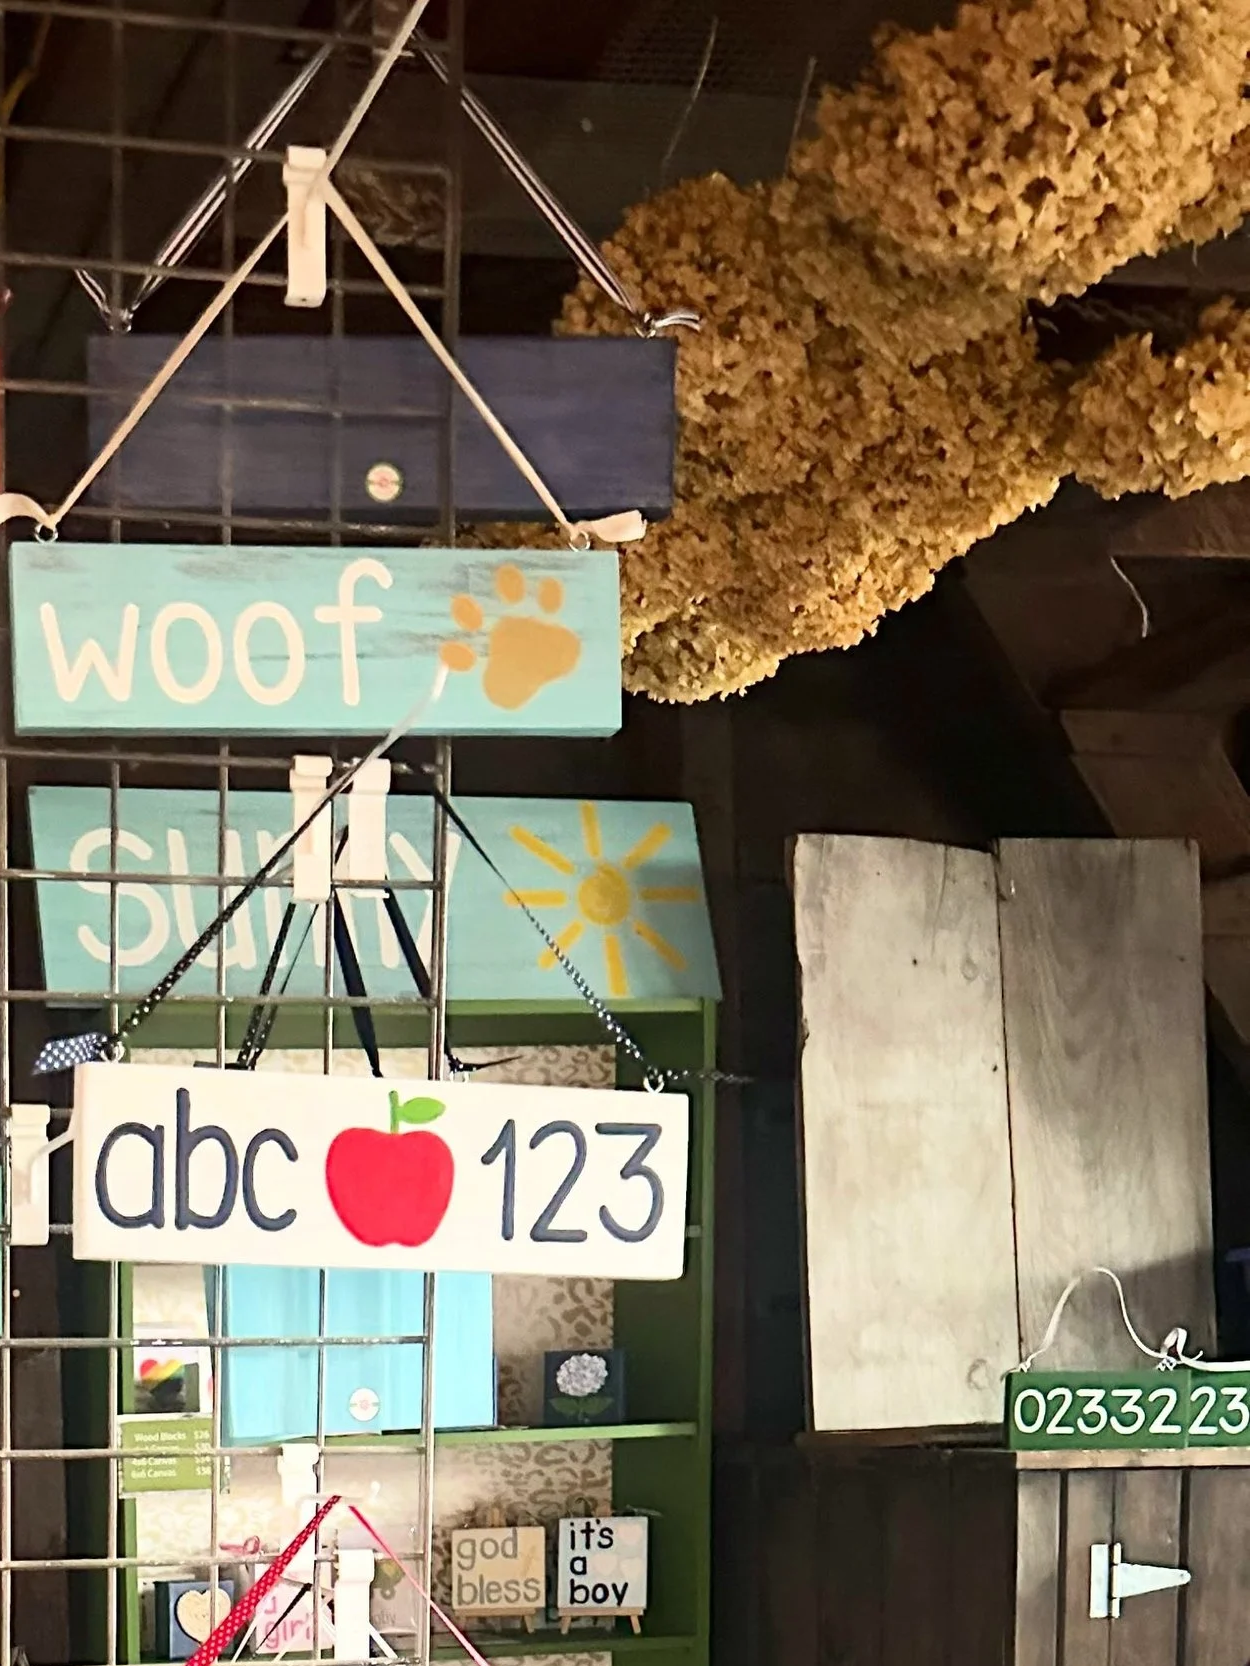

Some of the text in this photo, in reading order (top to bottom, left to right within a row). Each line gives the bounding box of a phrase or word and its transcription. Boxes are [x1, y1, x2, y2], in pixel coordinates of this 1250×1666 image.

[39, 558, 394, 707] woof
[95, 1087, 664, 1243] abc 123
[1014, 1387, 1182, 1435] 02332
[456, 1527, 518, 1571] god
[570, 1519, 614, 1550] it's
[569, 1556, 587, 1575] a
[457, 1574, 541, 1606] bless
[569, 1578, 629, 1607] boy
